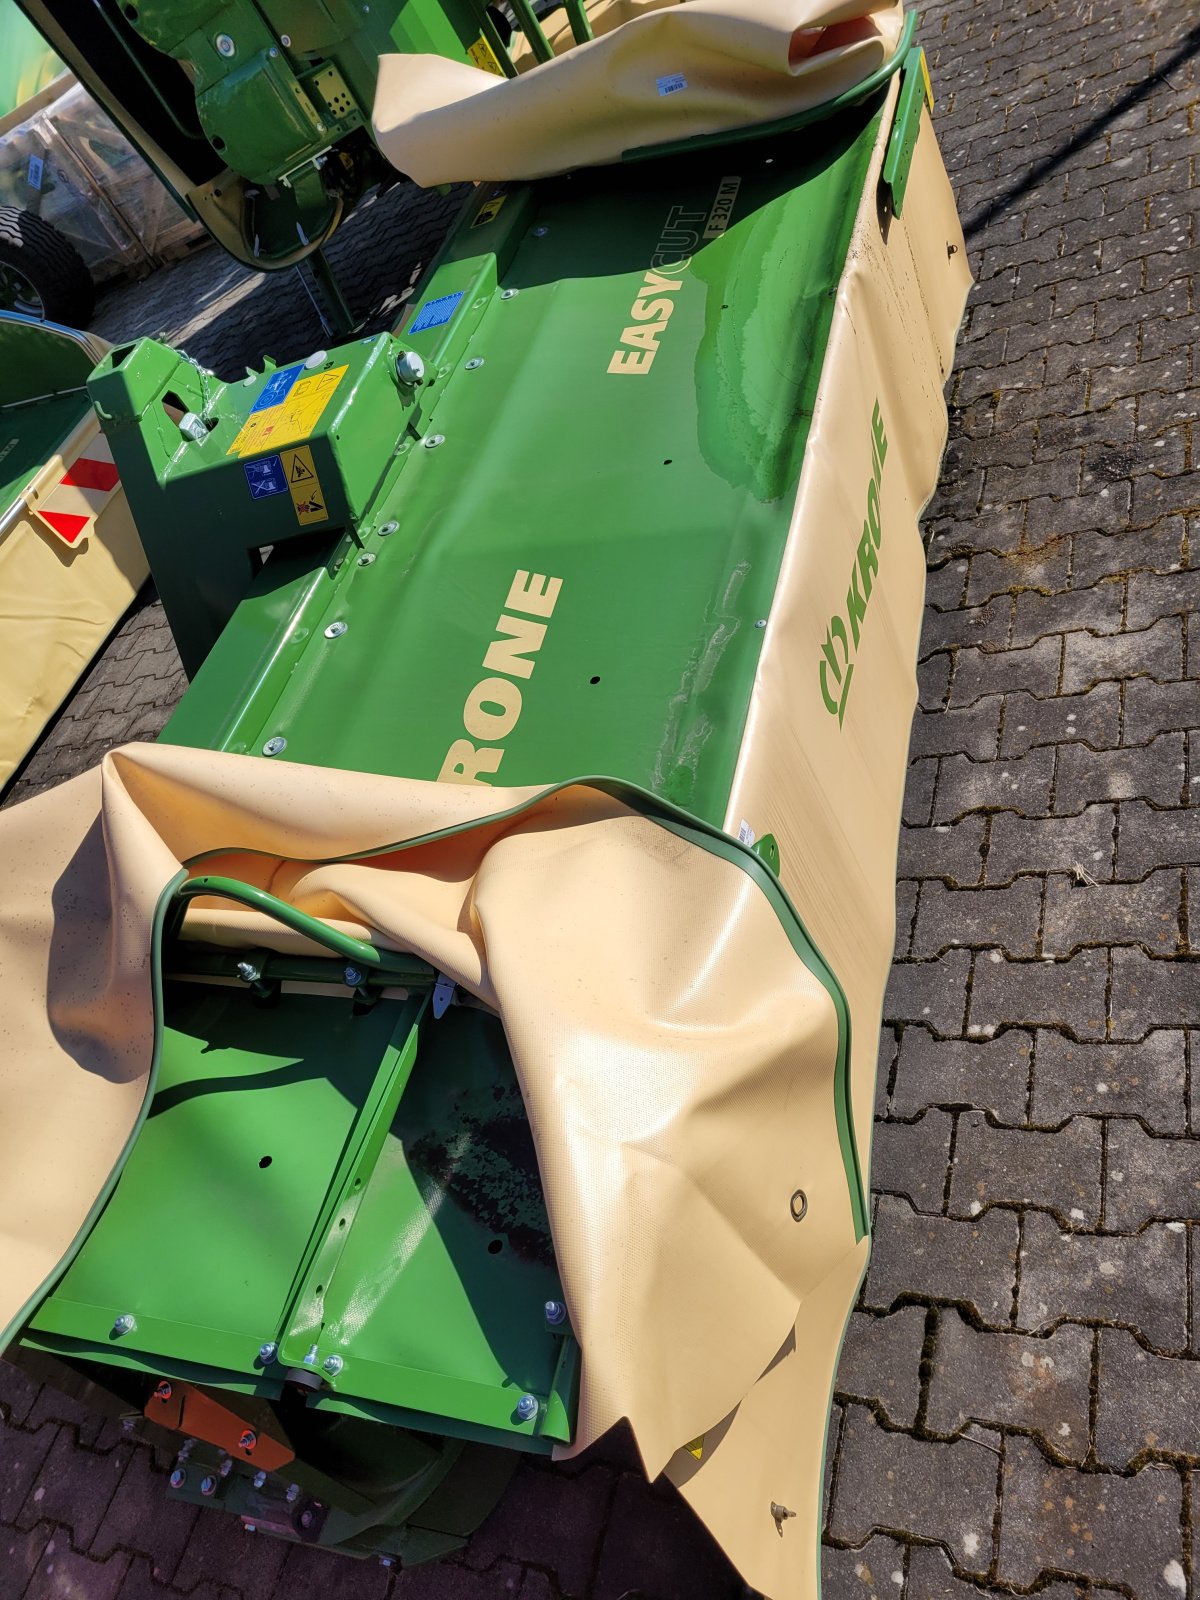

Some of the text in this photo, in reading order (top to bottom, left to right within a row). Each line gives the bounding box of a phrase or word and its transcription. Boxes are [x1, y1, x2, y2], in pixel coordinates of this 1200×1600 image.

[708, 182, 738, 232] F 320 M
[436, 569, 564, 788] RONE
